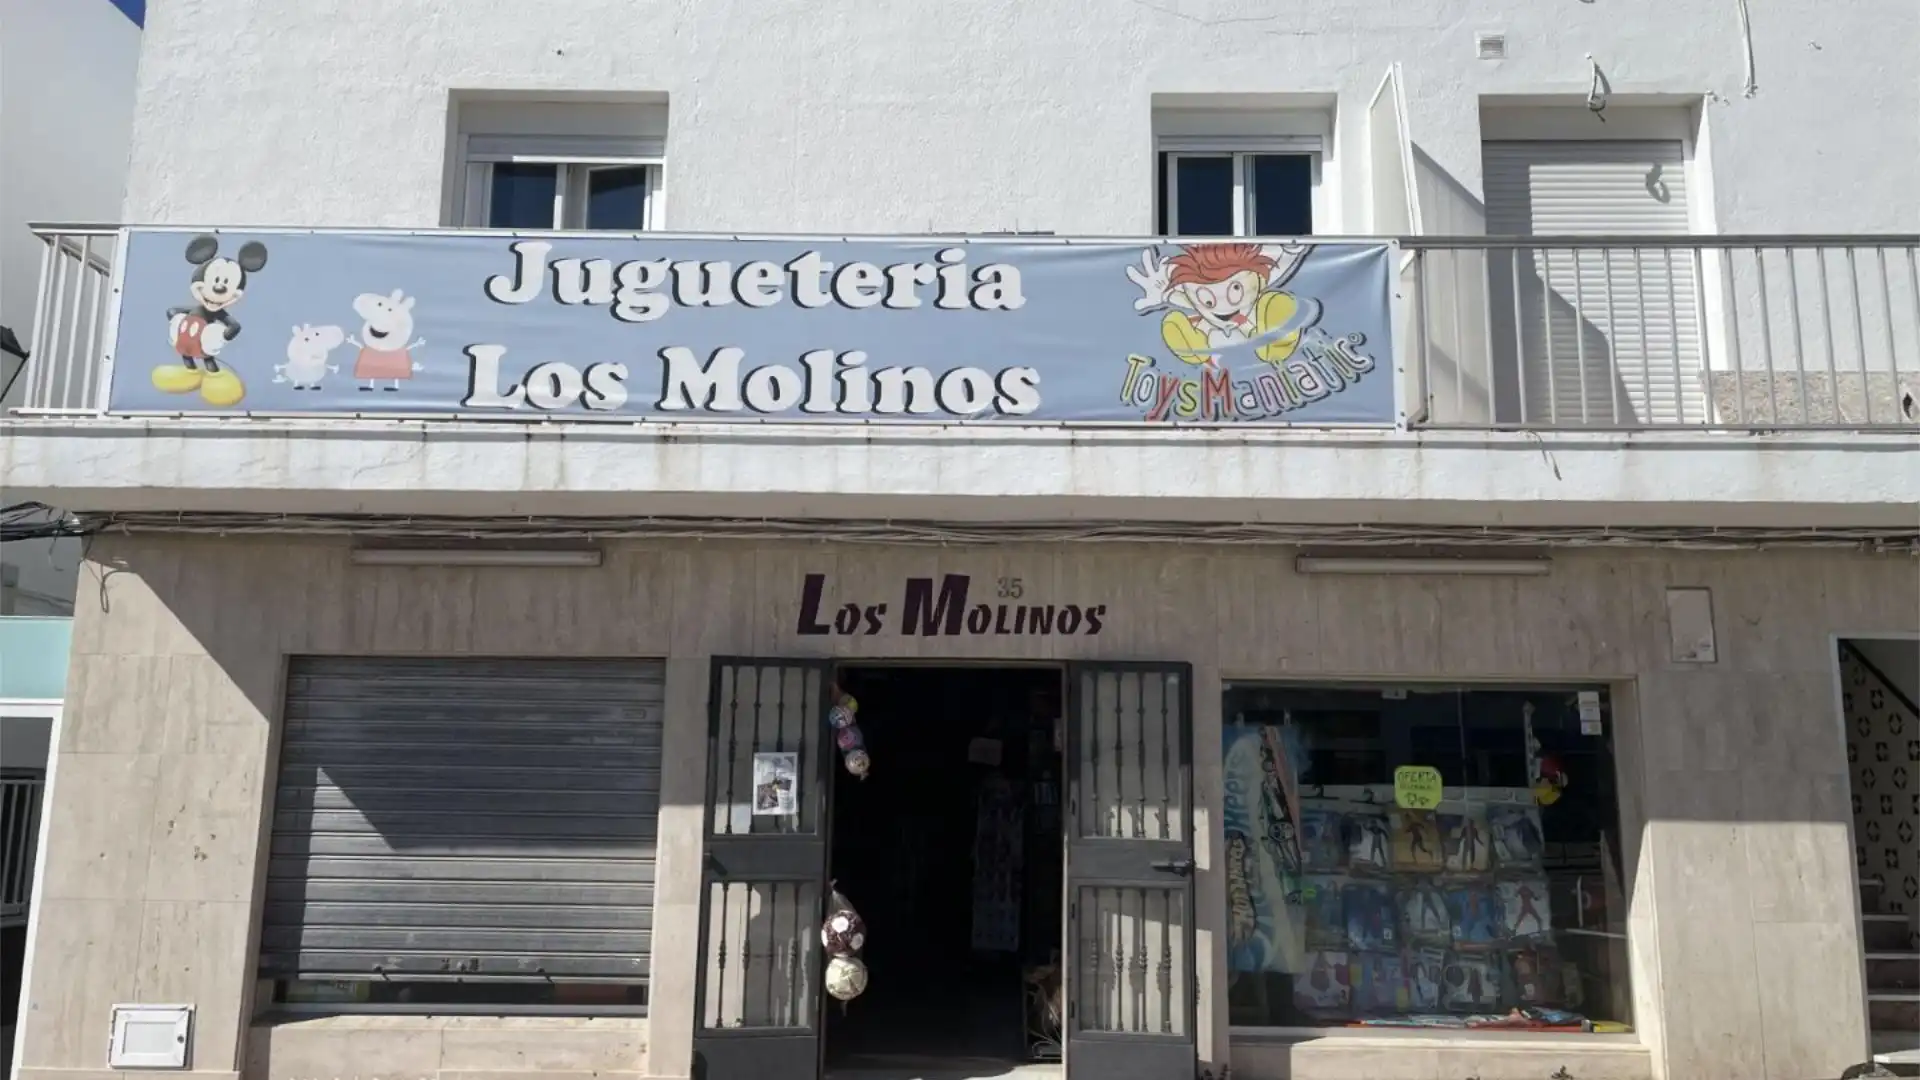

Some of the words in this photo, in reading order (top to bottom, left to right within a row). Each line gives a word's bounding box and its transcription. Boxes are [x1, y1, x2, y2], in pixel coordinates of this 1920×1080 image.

[484, 241, 1026, 323] Jugueteria
[462, 344, 629, 411] Los
[655, 346, 1042, 415] Molinos
[797, 573, 887, 635] LOS
[901, 573, 1107, 637] MOLINOS
[997, 577, 1023, 598] 35
